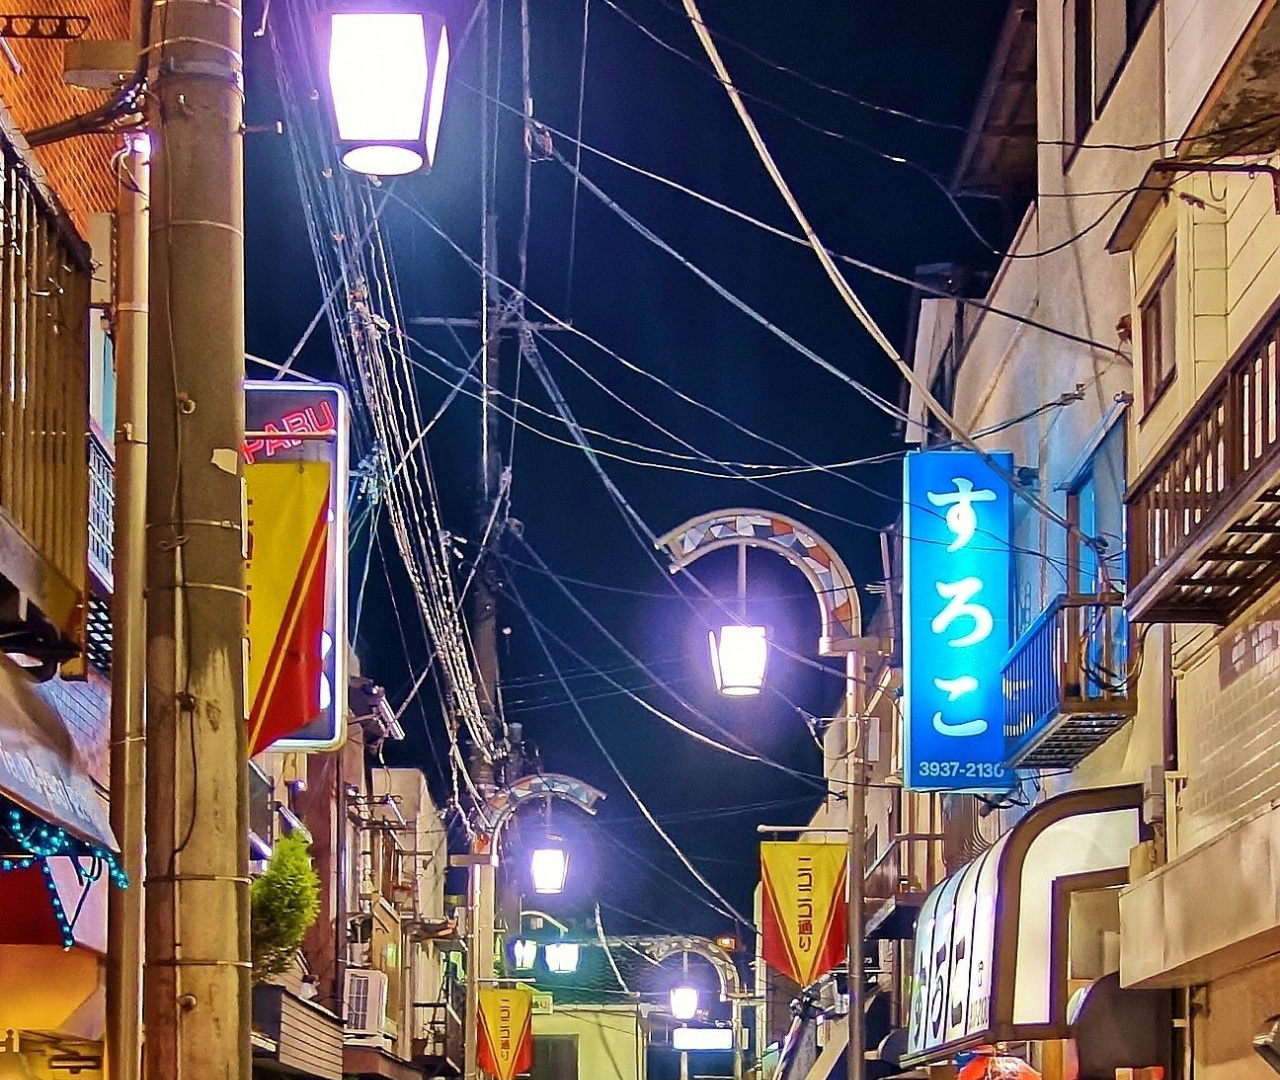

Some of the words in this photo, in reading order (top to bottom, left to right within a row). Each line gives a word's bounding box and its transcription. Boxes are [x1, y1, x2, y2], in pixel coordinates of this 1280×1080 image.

[926, 477, 998, 738] すろこ
[918, 761, 1005, 778] 3937-2130
